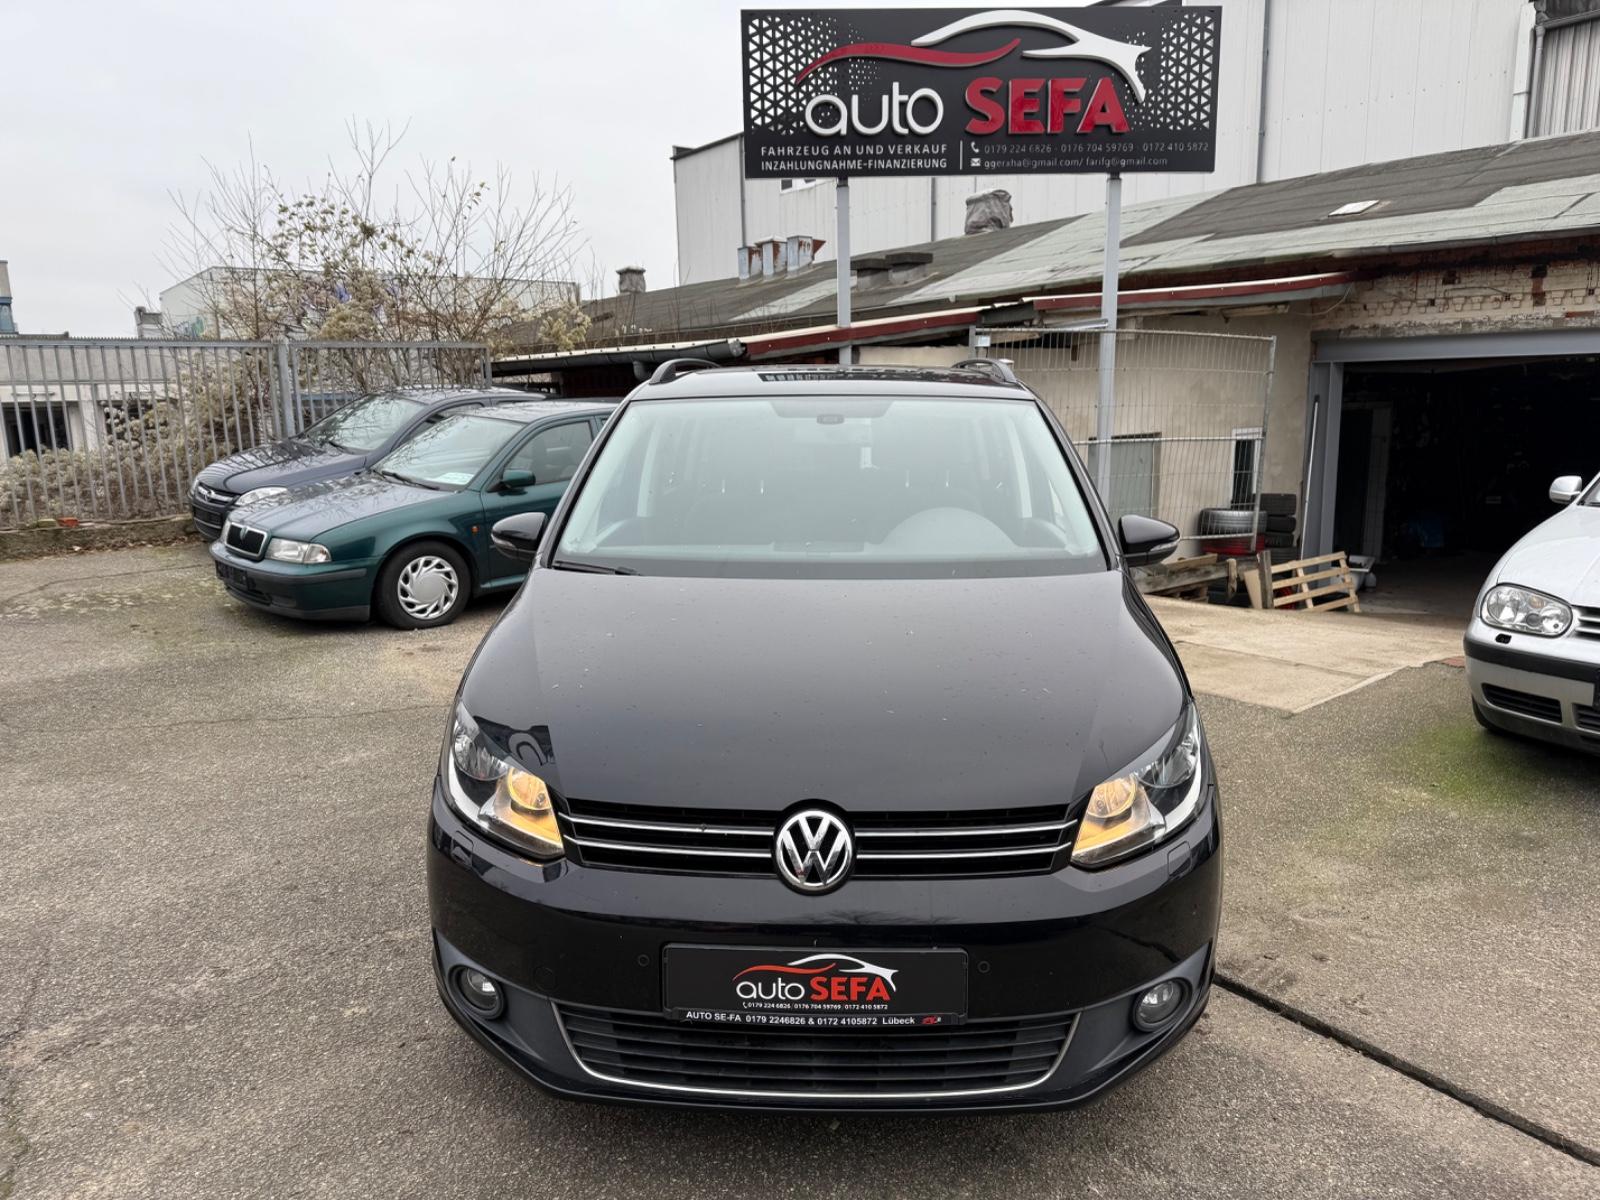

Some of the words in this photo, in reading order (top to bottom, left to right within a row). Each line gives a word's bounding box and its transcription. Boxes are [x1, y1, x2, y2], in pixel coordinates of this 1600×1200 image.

[805, 81, 944, 135] auto
[965, 77, 1130, 135] SEFA
[761, 145, 829, 157] FAHRZEUG
[834, 145, 851, 155] AN
[856, 144, 883, 155] UND
[888, 143, 947, 154] VERKAUF
[984, 143, 1007, 154] 0179
[1009, 143, 1026, 153] 224
[1029, 143, 1052, 153] 6826
[1061, 143, 1084, 153] 0176
[1087, 143, 1102, 152] 704
[1106, 142, 1134, 152] 59769
[1143, 142, 1165, 152] 0172
[1168, 142, 1184, 151] 410
[1188, 142, 1209, 151] 5872
[761, 158, 947, 171] INZAHLUNGNAHME-FINANZIERUNG
[736, 977, 806, 1000] auto
[810, 976, 891, 1001] SEFA
[686, 1011, 712, 1020] AUTO
[714, 1013, 741, 1022] SE-FA
[745, 1015, 767, 1023] 0179
[769, 1016, 806, 1025] 2246826
[808, 1017, 815, 1025] &
[817, 1017, 838, 1025] 0172
[840, 1017, 877, 1025] 4105872
[882, 1016, 915, 1025] Lübeck
